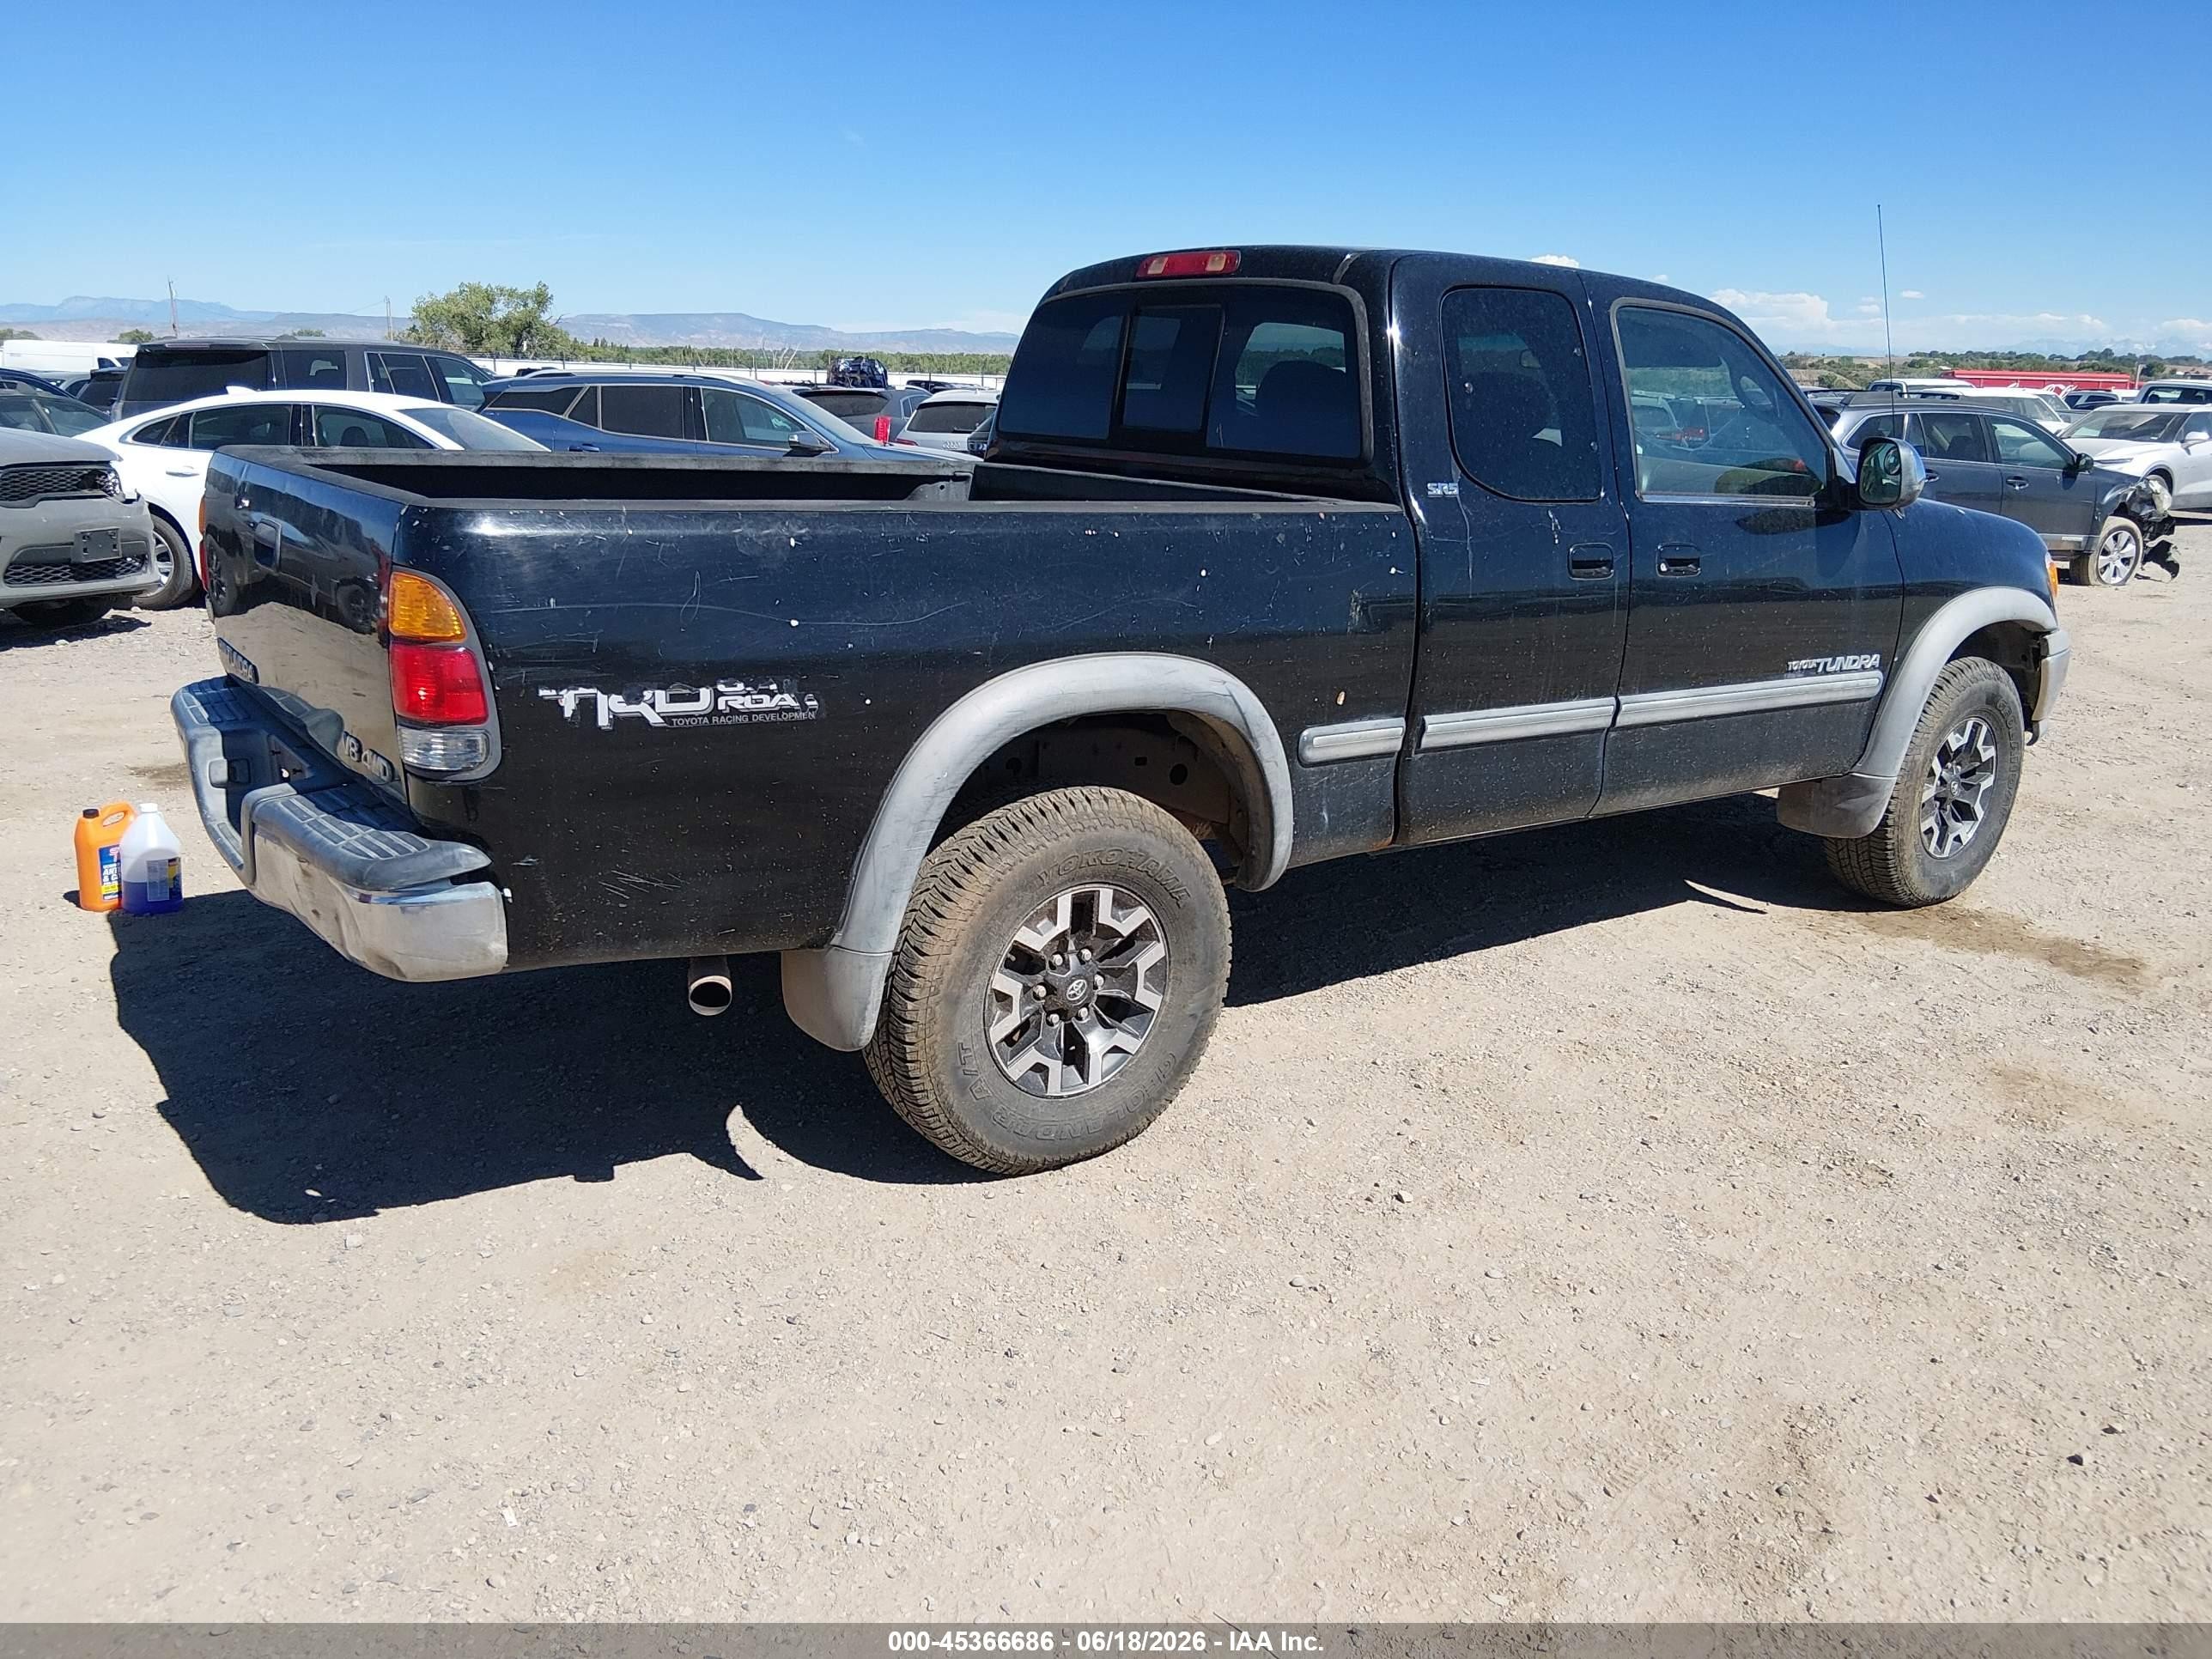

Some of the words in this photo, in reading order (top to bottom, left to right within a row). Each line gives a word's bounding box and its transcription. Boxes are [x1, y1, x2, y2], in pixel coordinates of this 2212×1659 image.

[1427, 483, 1459, 497] SR5
[1787, 659, 1817, 672] TOYOTA
[1816, 654, 1881, 673] TUNDRA
[672, 716, 709, 726] TOYOTA
[712, 714, 749, 724] RACING
[752, 711, 817, 722] DEVELOPMEN
[1036, 847, 1193, 909] YOKOHAMA
[992, 1052, 1178, 1141] GEOLANDAR
